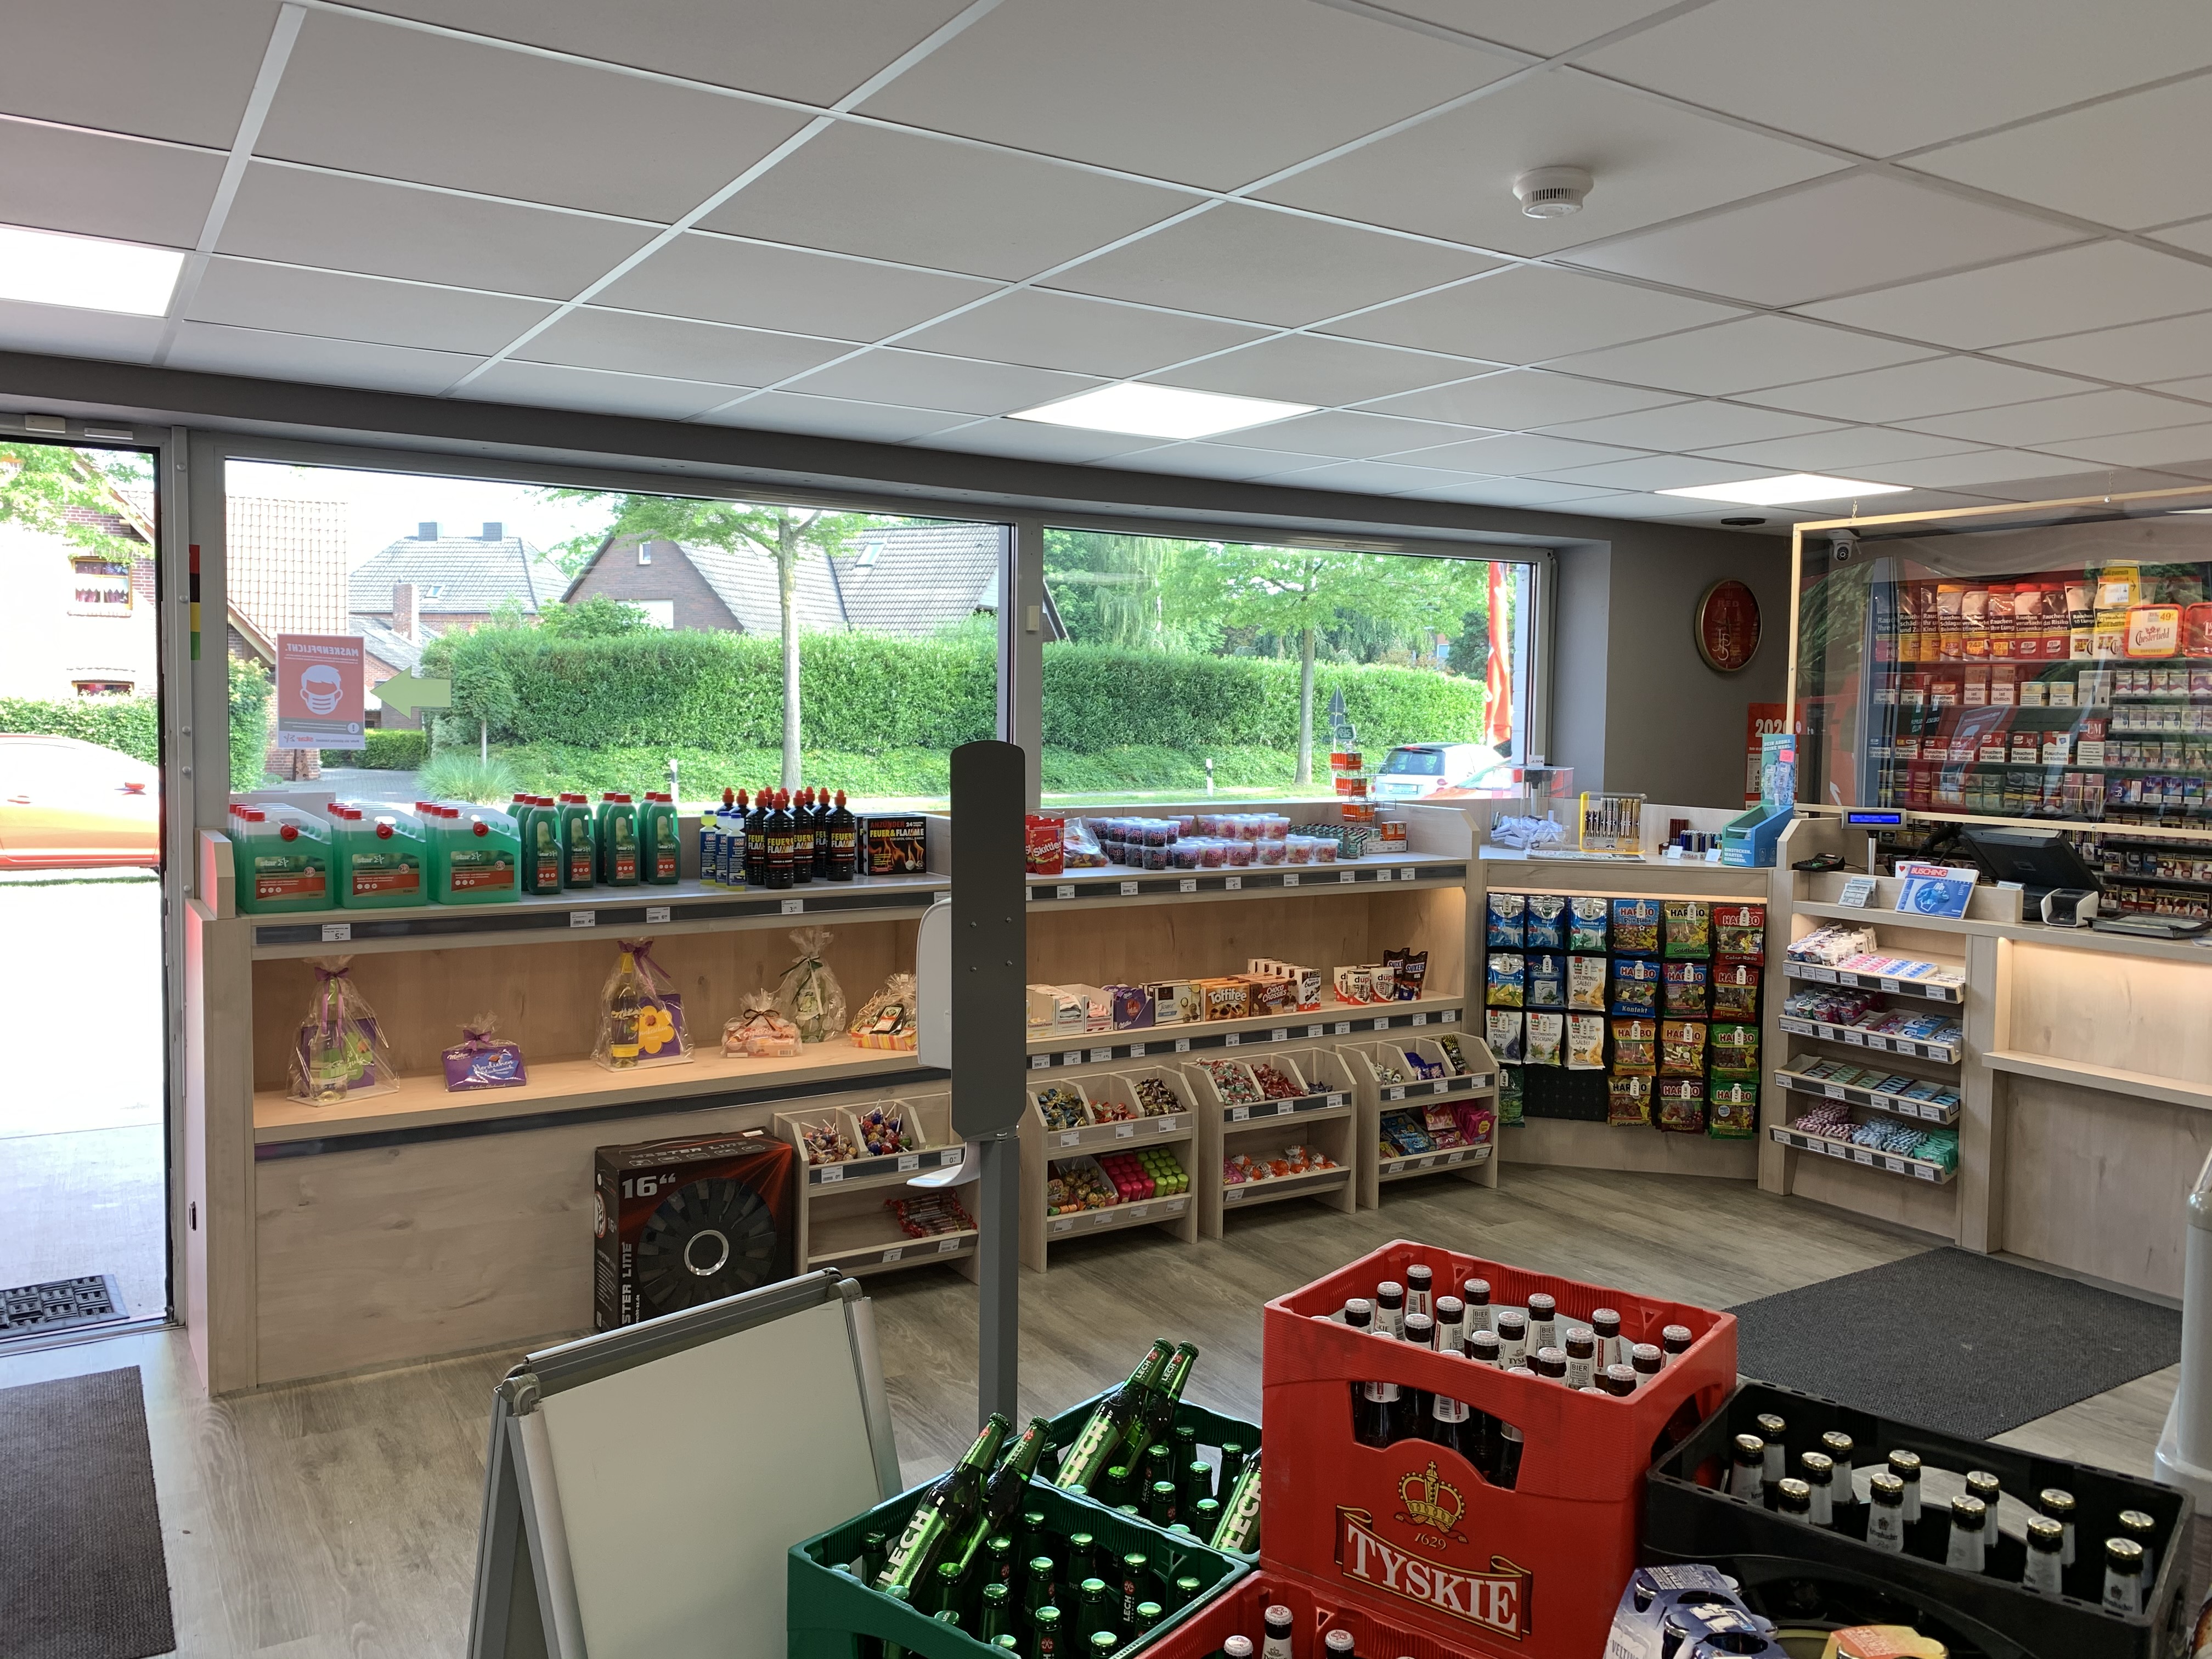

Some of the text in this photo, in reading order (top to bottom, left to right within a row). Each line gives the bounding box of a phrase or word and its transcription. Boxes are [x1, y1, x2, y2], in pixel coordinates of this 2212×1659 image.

[2136, 629, 2170, 646] Chesterfield
[1756, 719, 1787, 737] 202
[870, 820, 905, 828] ANZÜNDER
[1910, 867, 1948, 877] BUSCHING
[1532, 963, 1559, 972] Rila
[1208, 988, 1247, 1005] Toffifee
[1262, 990, 1286, 1003] CROSSIES
[1266, 985, 1284, 994] CHOCO
[1622, 1005, 1647, 1013] Konfekt
[1118, 1020, 1132, 1030] Milka
[472, 1060, 514, 1070] Herzlichen
[630, 1141, 747, 1159] MASTER LINE
[622, 1243, 631, 1324] STER LINE
[1473, 1310, 1488, 1318] BIER
[1541, 1326, 1555, 1334] BIER
[1136, 1359, 1151, 1379] LECH
[1162, 1363, 1176, 1382] LECH
[1571, 1363, 1588, 1372] BIER
[1009, 1441, 1027, 1462] LECH
[1062, 1418, 1109, 1484] LECH
[1222, 1478, 1262, 1548] LECH
[879, 1509, 931, 1583] LECH
[1414, 1532, 1447, 1551] 1629
[1347, 1523, 1517, 1634] TYSKIE
[1122, 1594, 1132, 1623] LECH
